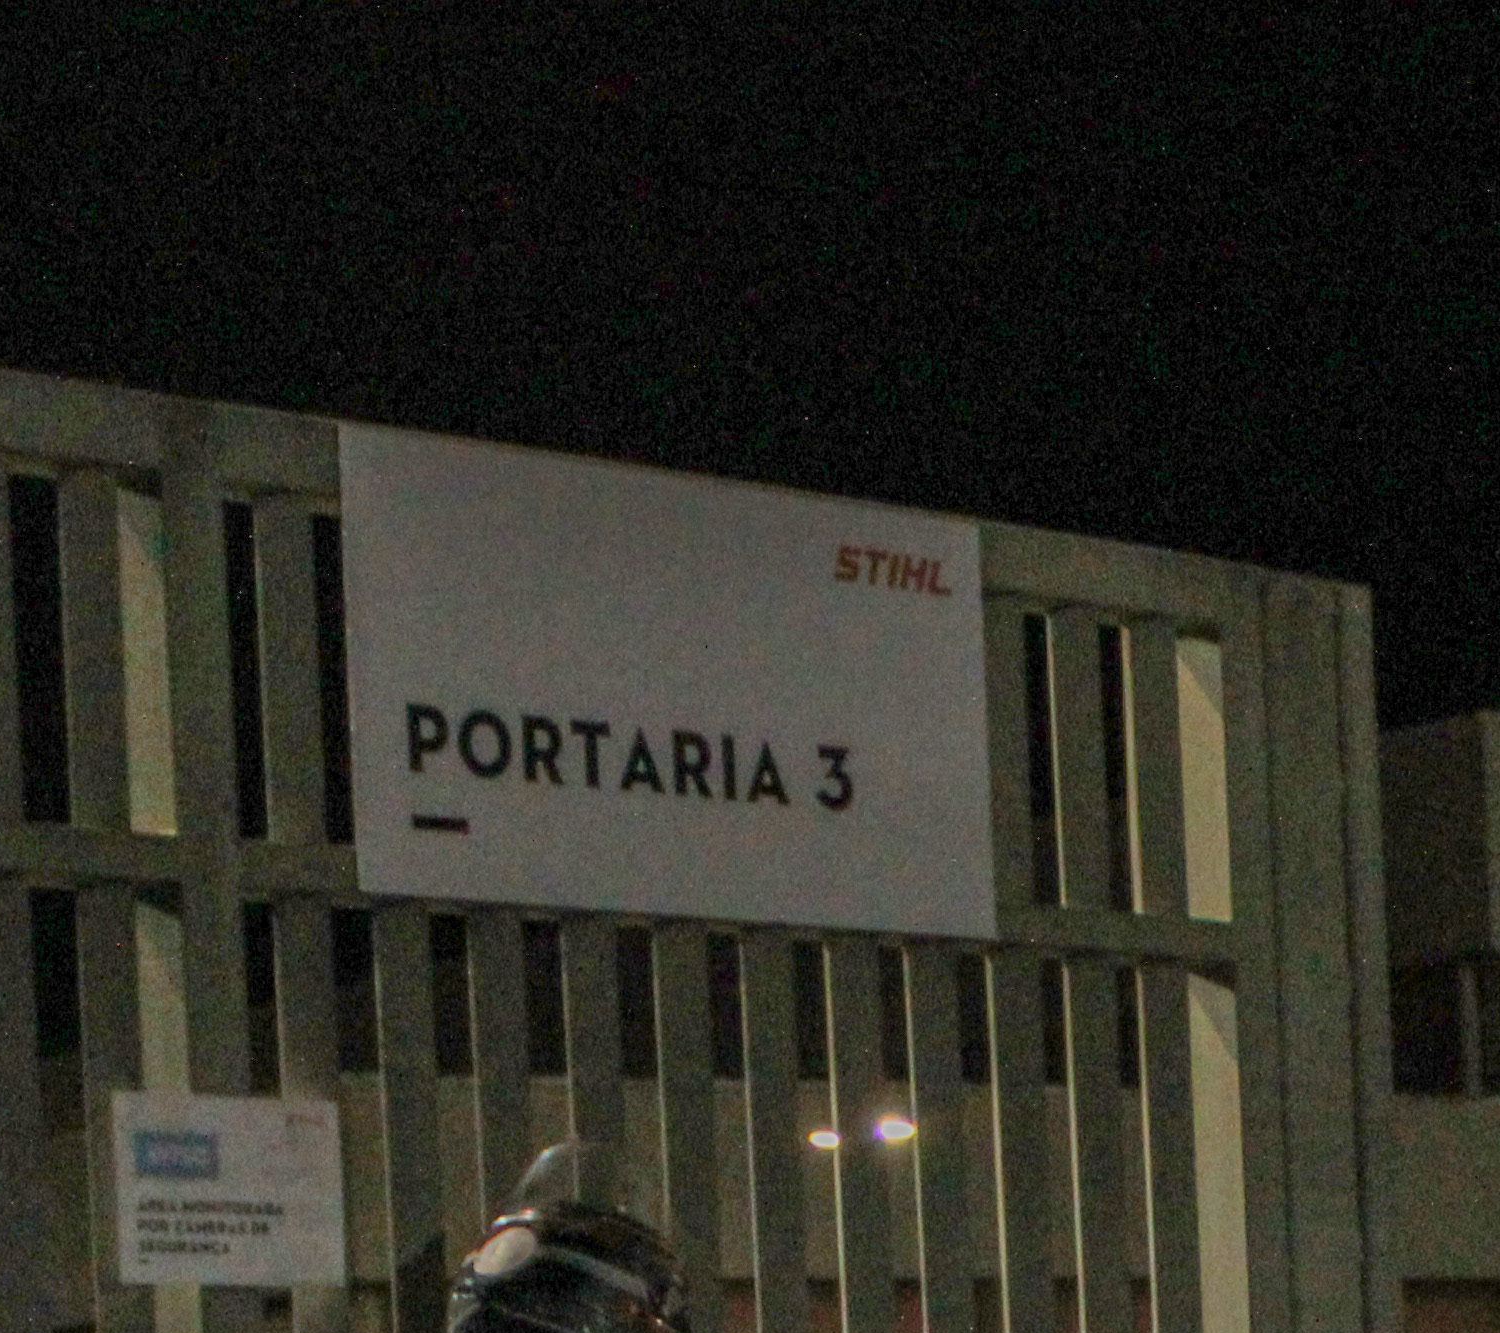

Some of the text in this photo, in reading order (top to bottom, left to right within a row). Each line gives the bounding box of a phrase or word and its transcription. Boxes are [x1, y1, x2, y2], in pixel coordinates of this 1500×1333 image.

[834, 545, 953, 598] STIHL
[406, 702, 856, 811] PORTARIA 3
